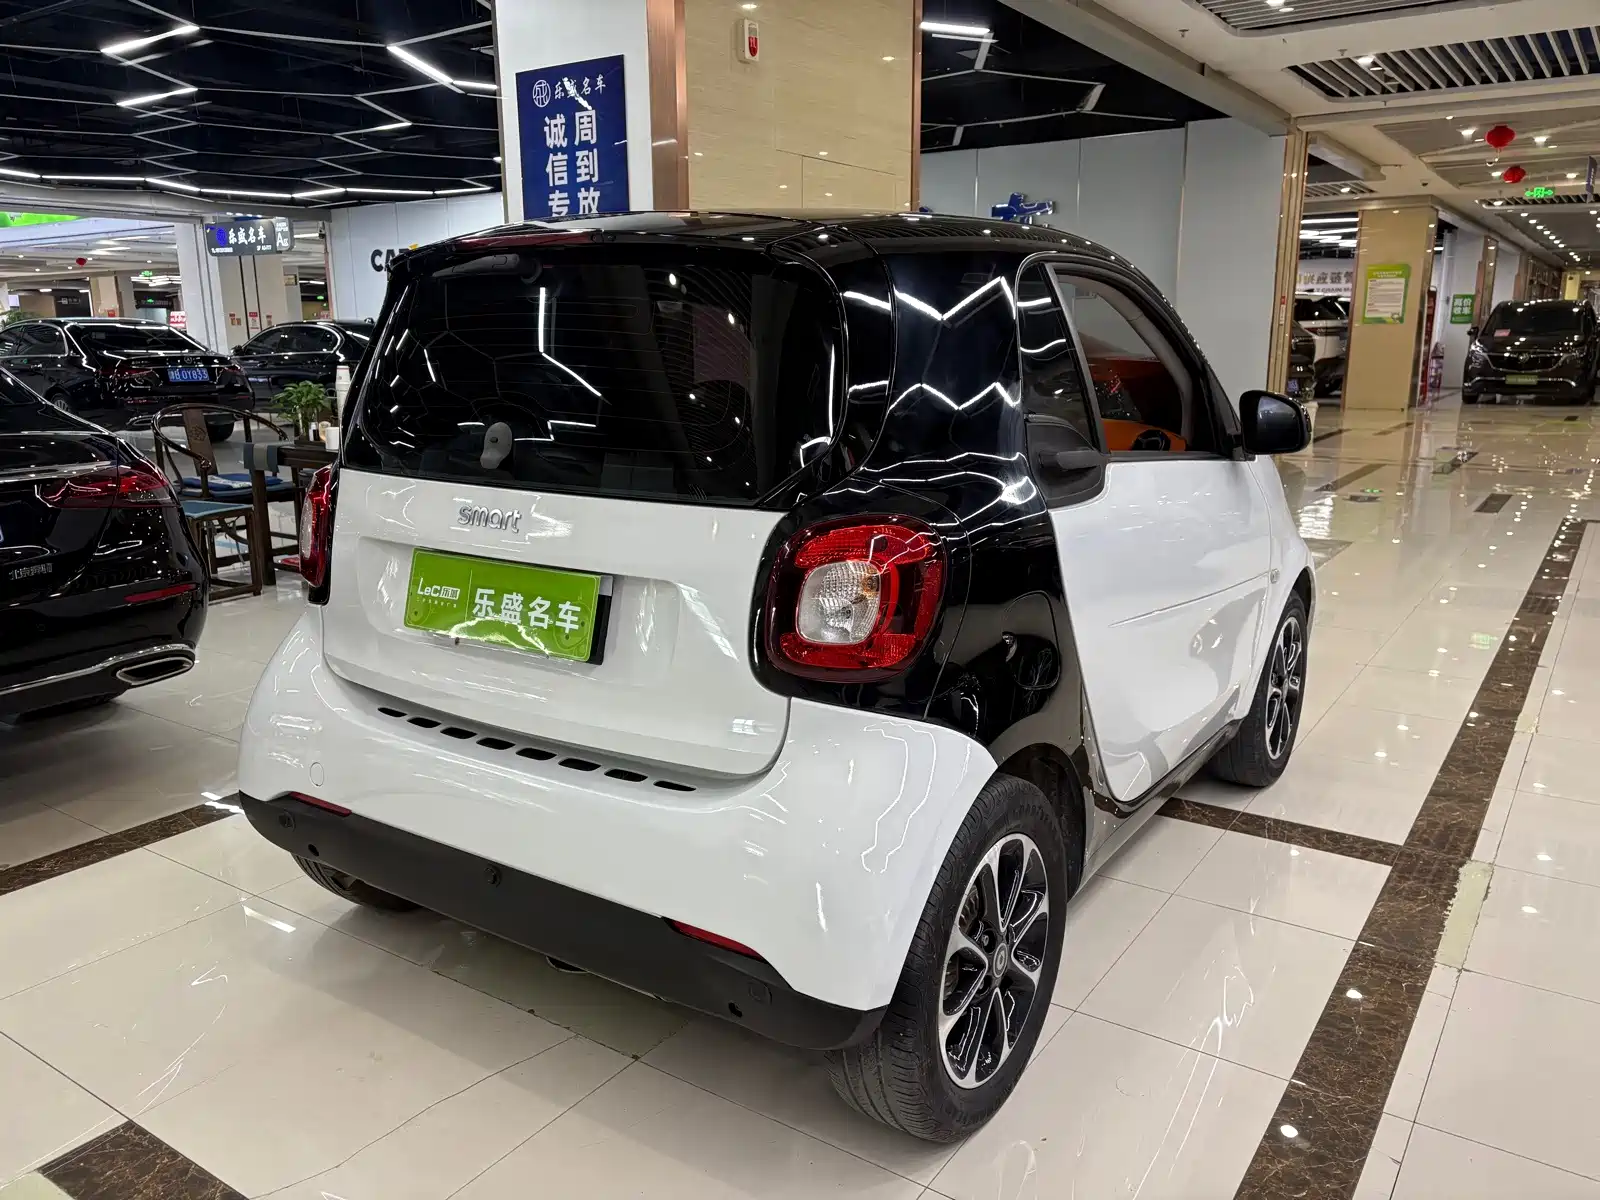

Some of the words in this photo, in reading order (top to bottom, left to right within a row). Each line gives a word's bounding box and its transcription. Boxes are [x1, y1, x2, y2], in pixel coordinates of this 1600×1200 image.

[457, 504, 522, 533] smart
[472, 588, 582, 634] 乐盛名车
